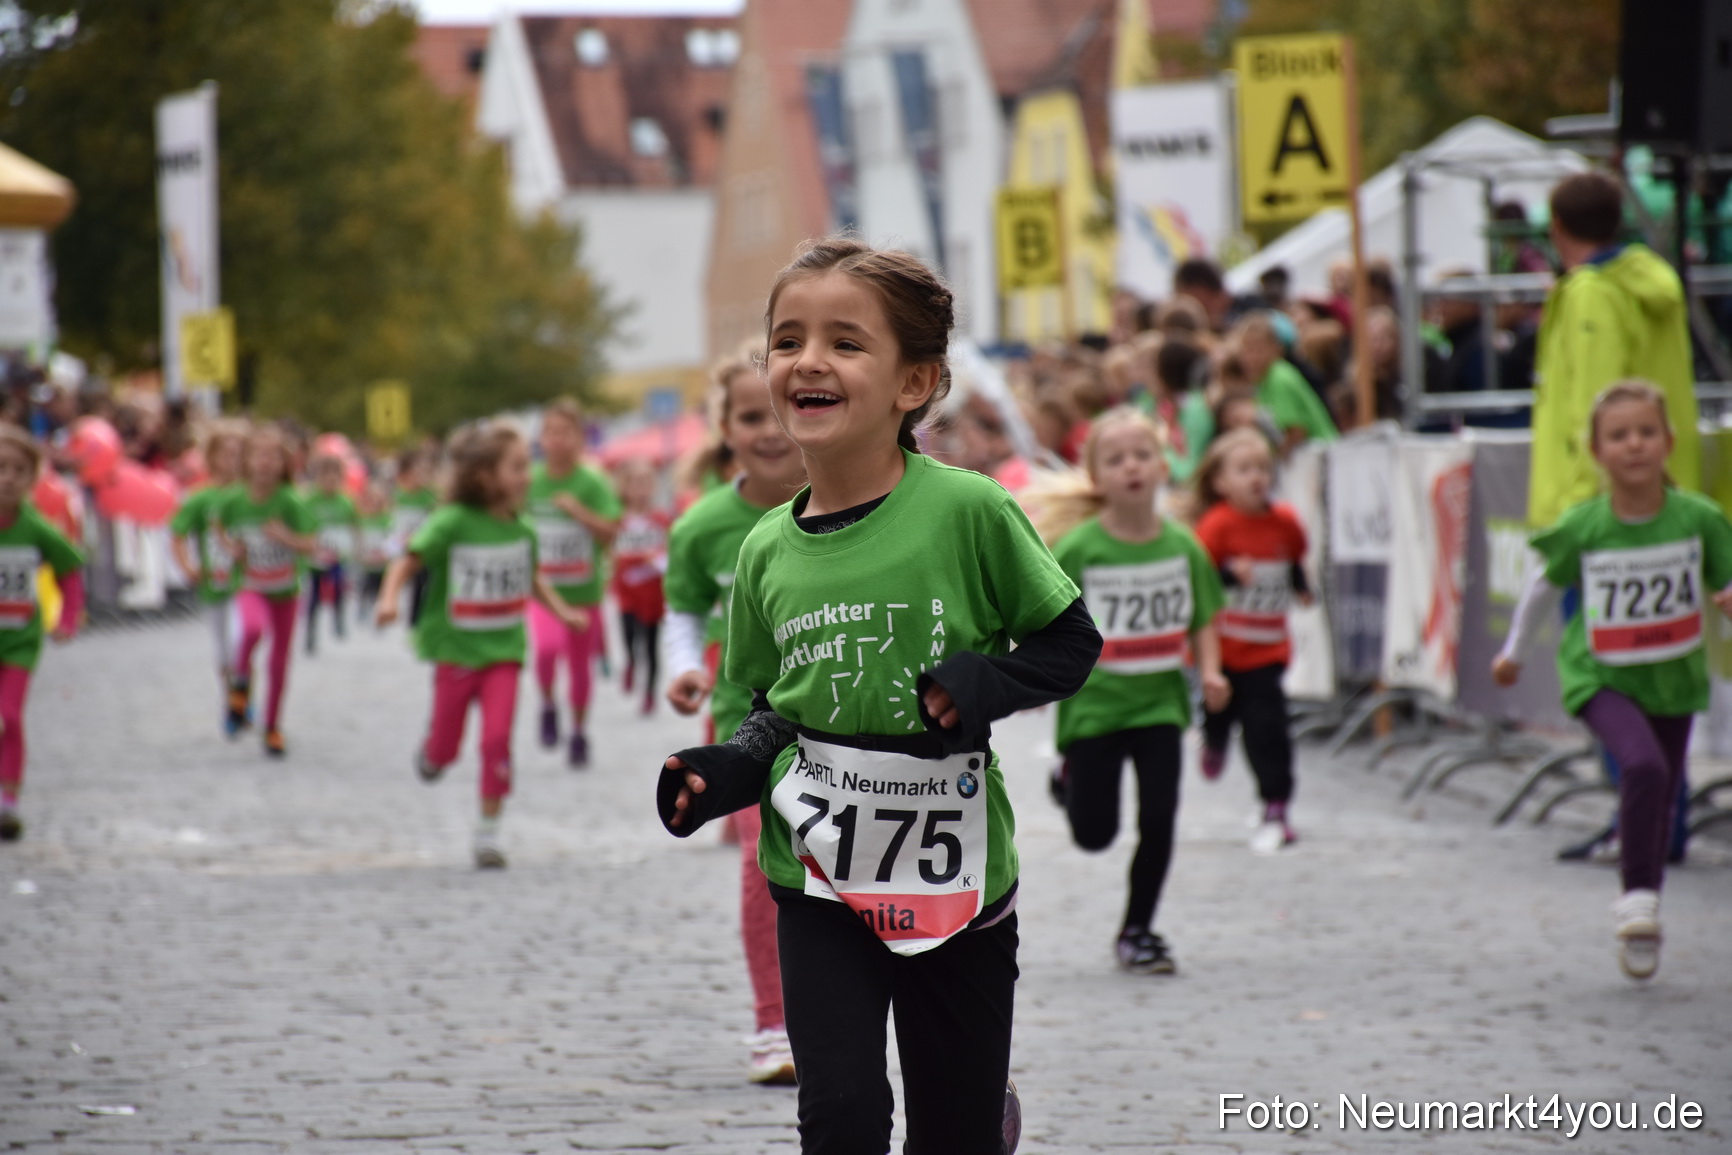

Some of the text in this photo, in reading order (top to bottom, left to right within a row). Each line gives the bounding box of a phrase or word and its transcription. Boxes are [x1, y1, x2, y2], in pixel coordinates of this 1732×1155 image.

[1271, 93, 1332, 174] A
[1013, 216, 1051, 270] B
[1101, 585, 1186, 632] 7202
[1597, 568, 1695, 621] 7224
[795, 757, 948, 796] PARTL Neumarkt
[797, 792, 963, 885] 7175
[859, 902, 915, 932] nita
